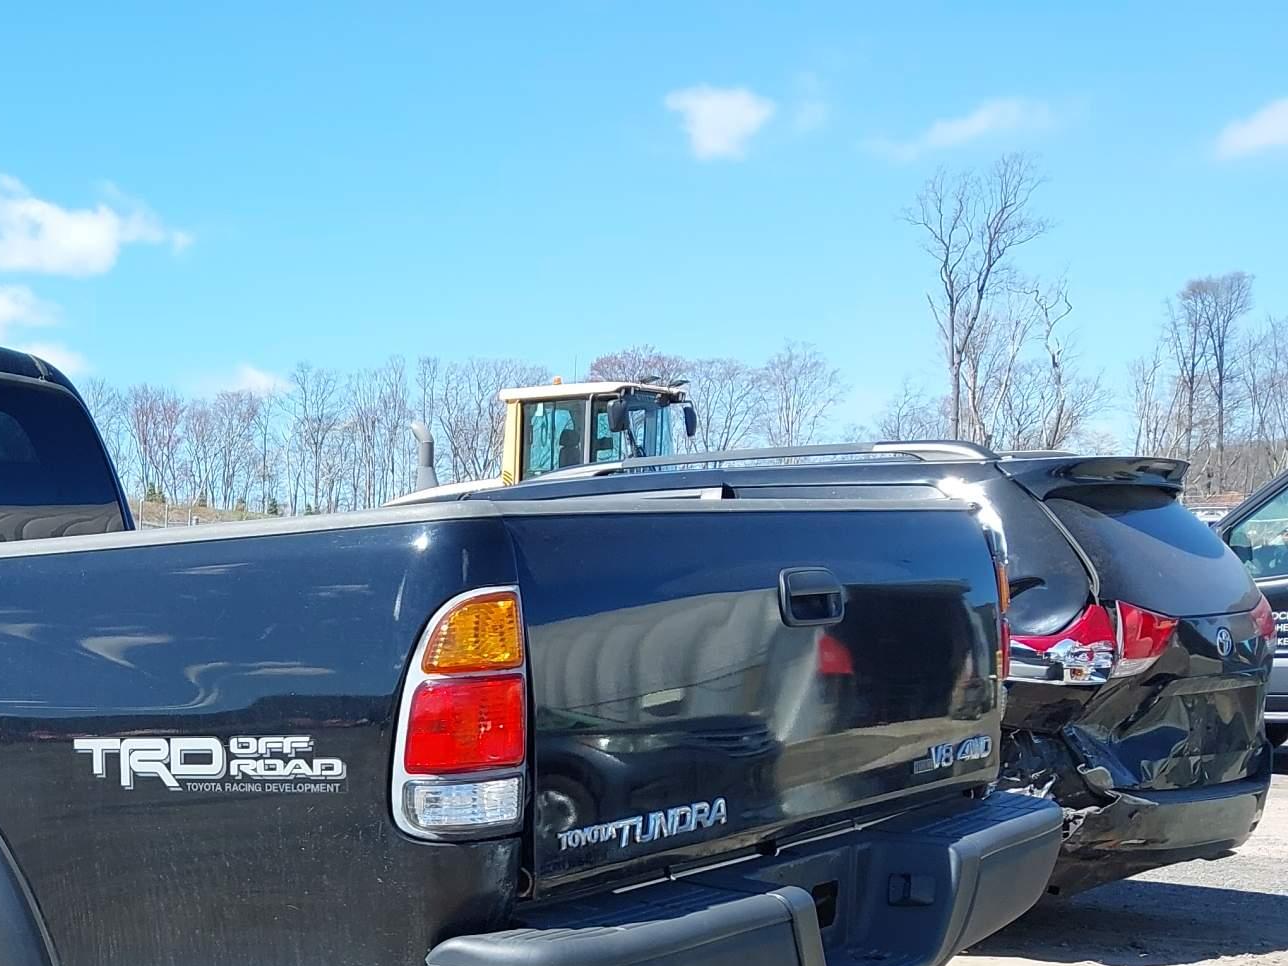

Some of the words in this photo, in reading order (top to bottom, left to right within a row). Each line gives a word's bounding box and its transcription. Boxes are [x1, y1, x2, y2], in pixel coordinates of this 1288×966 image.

[229, 735, 314, 757] OFF
[931, 743, 954, 769] V8
[957, 735, 992, 761] 4WD
[73, 735, 229, 791] TRD
[229, 758, 347, 780] ROAD
[186, 782, 223, 793] TOYOTA
[225, 782, 262, 793] RACING
[265, 782, 341, 793] DEVELOPMENT
[557, 822, 618, 851] TOYOTA
[614, 797, 728, 848] TUNDRA
